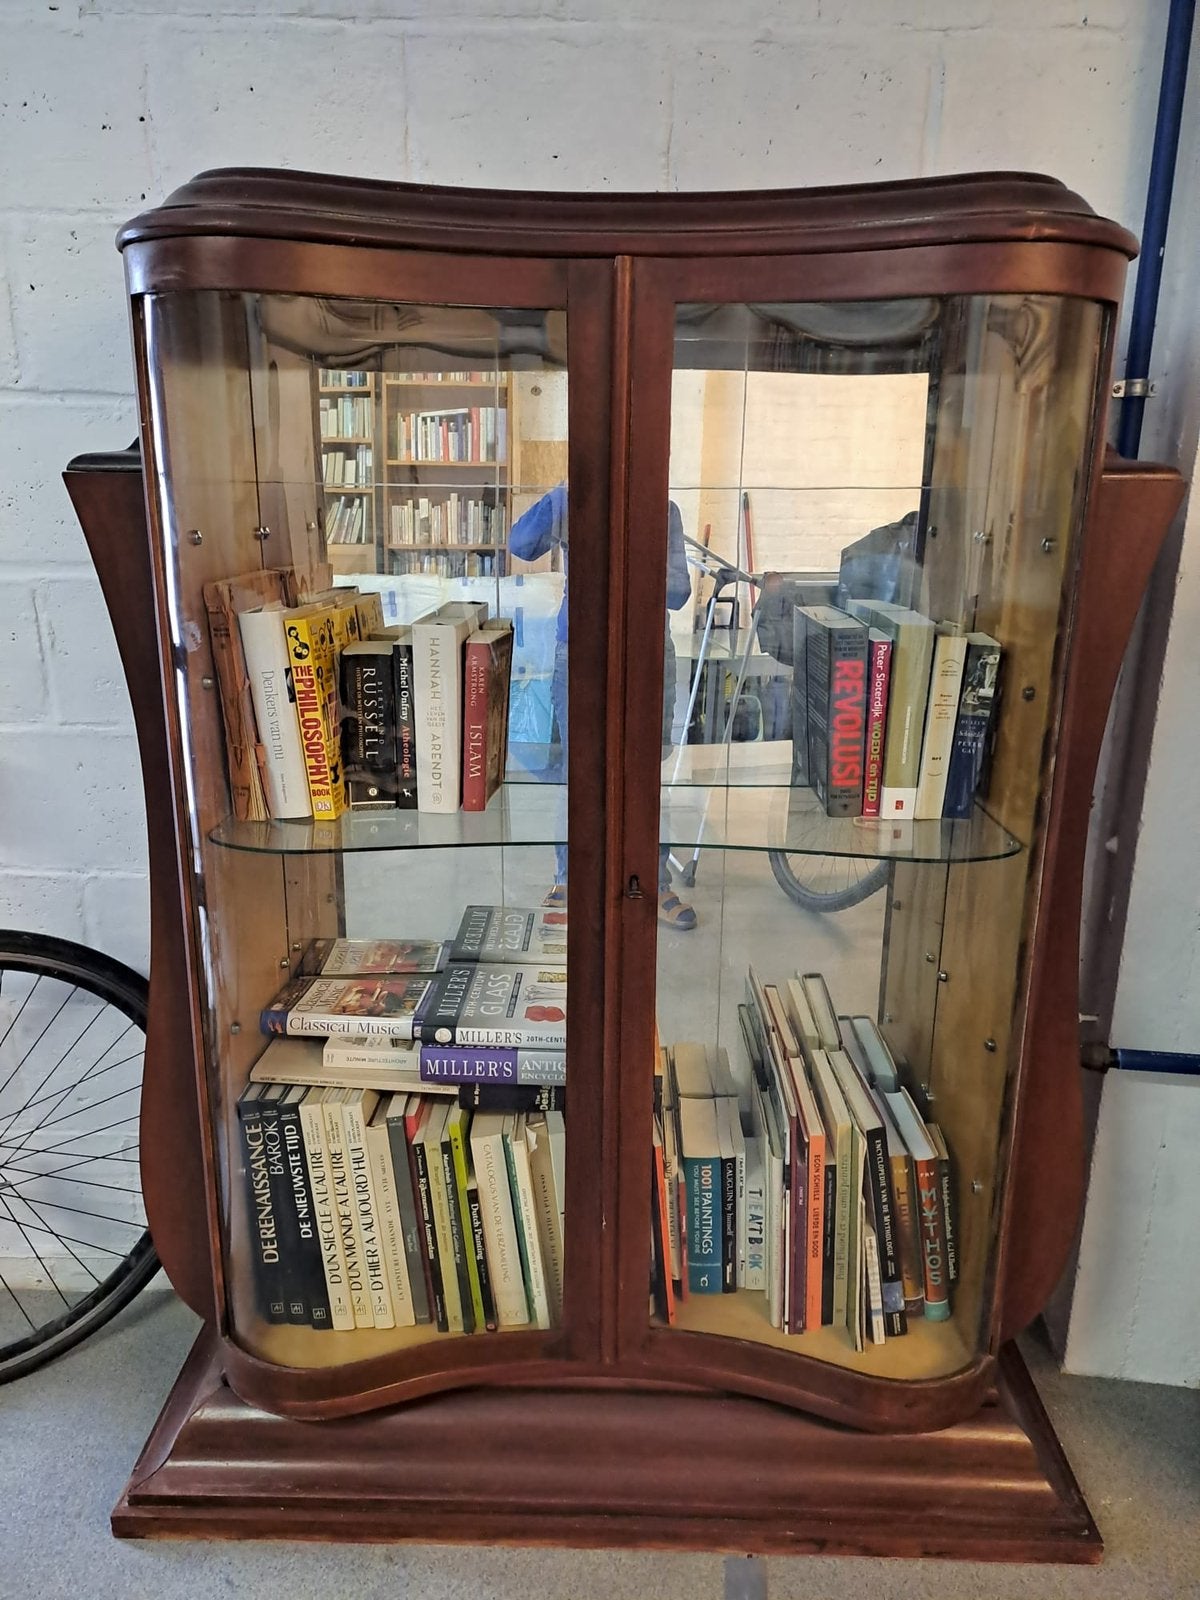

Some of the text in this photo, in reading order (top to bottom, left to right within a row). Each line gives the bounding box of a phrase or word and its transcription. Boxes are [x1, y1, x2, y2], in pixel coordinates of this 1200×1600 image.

[293, 665, 313, 678] THE
[877, 644, 887, 670] Peter
[261, 670, 278, 717] Denkers
[470, 655, 478, 707] ARMSTRONG
[872, 672, 885, 717] Sloterdijk
[269, 720, 280, 741] van
[362, 667, 378, 759] RUSSELL
[400, 657, 412, 778] Michel Onfray Atheologie
[429, 638, 442, 788] HANNAH ARENDT
[832, 660, 863, 787] REVOLUSI
[294, 678, 330, 787] PHILOSOPHY
[468, 724, 482, 778] ISLAM
[870, 721, 882, 761] WOEDE
[274, 743, 286, 760] nu
[869, 763, 878, 777] en
[311, 788, 330, 796] BOOK
[867, 778, 878, 802] TIJD
[437, 969, 471, 1017] MILLER'S
[464, 971, 487, 1017] 20TH-CENTURY
[480, 974, 511, 1015] GLASS
[289, 1017, 350, 1032] Classical
[357, 1023, 400, 1035] Music
[459, 1030, 522, 1044] MILLER'S
[426, 1060, 512, 1077] MILLER'S
[263, 1120, 284, 1175] BAROK
[284, 1124, 301, 1151] TIJD
[245, 1123, 275, 1236] RENAISSANCE
[290, 1154, 310, 1218] NIEUWSTE
[309, 1148, 328, 1195] L'AUTRE
[330, 1148, 347, 1195] L'AUTRE
[442, 1153, 454, 1184] Mauritshuis
[726, 1162, 734, 1202] GAUGUIN
[840, 1154, 849, 1188] peintres
[875, 1139, 886, 1187] ENCYCLOPEDIE
[882, 1205, 889, 1213] DE
[319, 1197, 330, 1207] A
[336, 1198, 349, 1208] A
[418, 1178, 431, 1220] Rijksmuseum
[540, 1173, 551, 1208] PICASSO
[725, 1203, 734, 1212] by
[812, 1154, 821, 1258] EGON SCHIELE LIEFDE EN DOOD
[350, 1147, 384, 1291] D'HIER A AUJOURD'HUI
[447, 1200, 457, 1219] Painting
[470, 1203, 482, 1226] Dutch
[482, 1144, 511, 1284] CATALOGUS VAN DE VERZAMELING
[701, 1164, 713, 1255] 1001 PAINTINGS
[726, 1213, 735, 1236] himself
[299, 1221, 313, 1238] DE
[321, 1210, 337, 1251] SIECLE
[339, 1211, 357, 1258] MONDE
[388, 1219, 399, 1256] FLAMANDE
[424, 1223, 436, 1260] Amsterdam
[472, 1228, 485, 1260] Painting
[838, 1233, 846, 1260] Eluard
[921, 1187, 943, 1285] MYTHOS
[262, 1240, 279, 1263] DE
[325, 1253, 342, 1284] D'UN
[344, 1261, 363, 1291] D'UN
[394, 1258, 403, 1290] PEINTURE
[836, 1263, 845, 1280] Paul
[399, 1291, 405, 1301] LA
